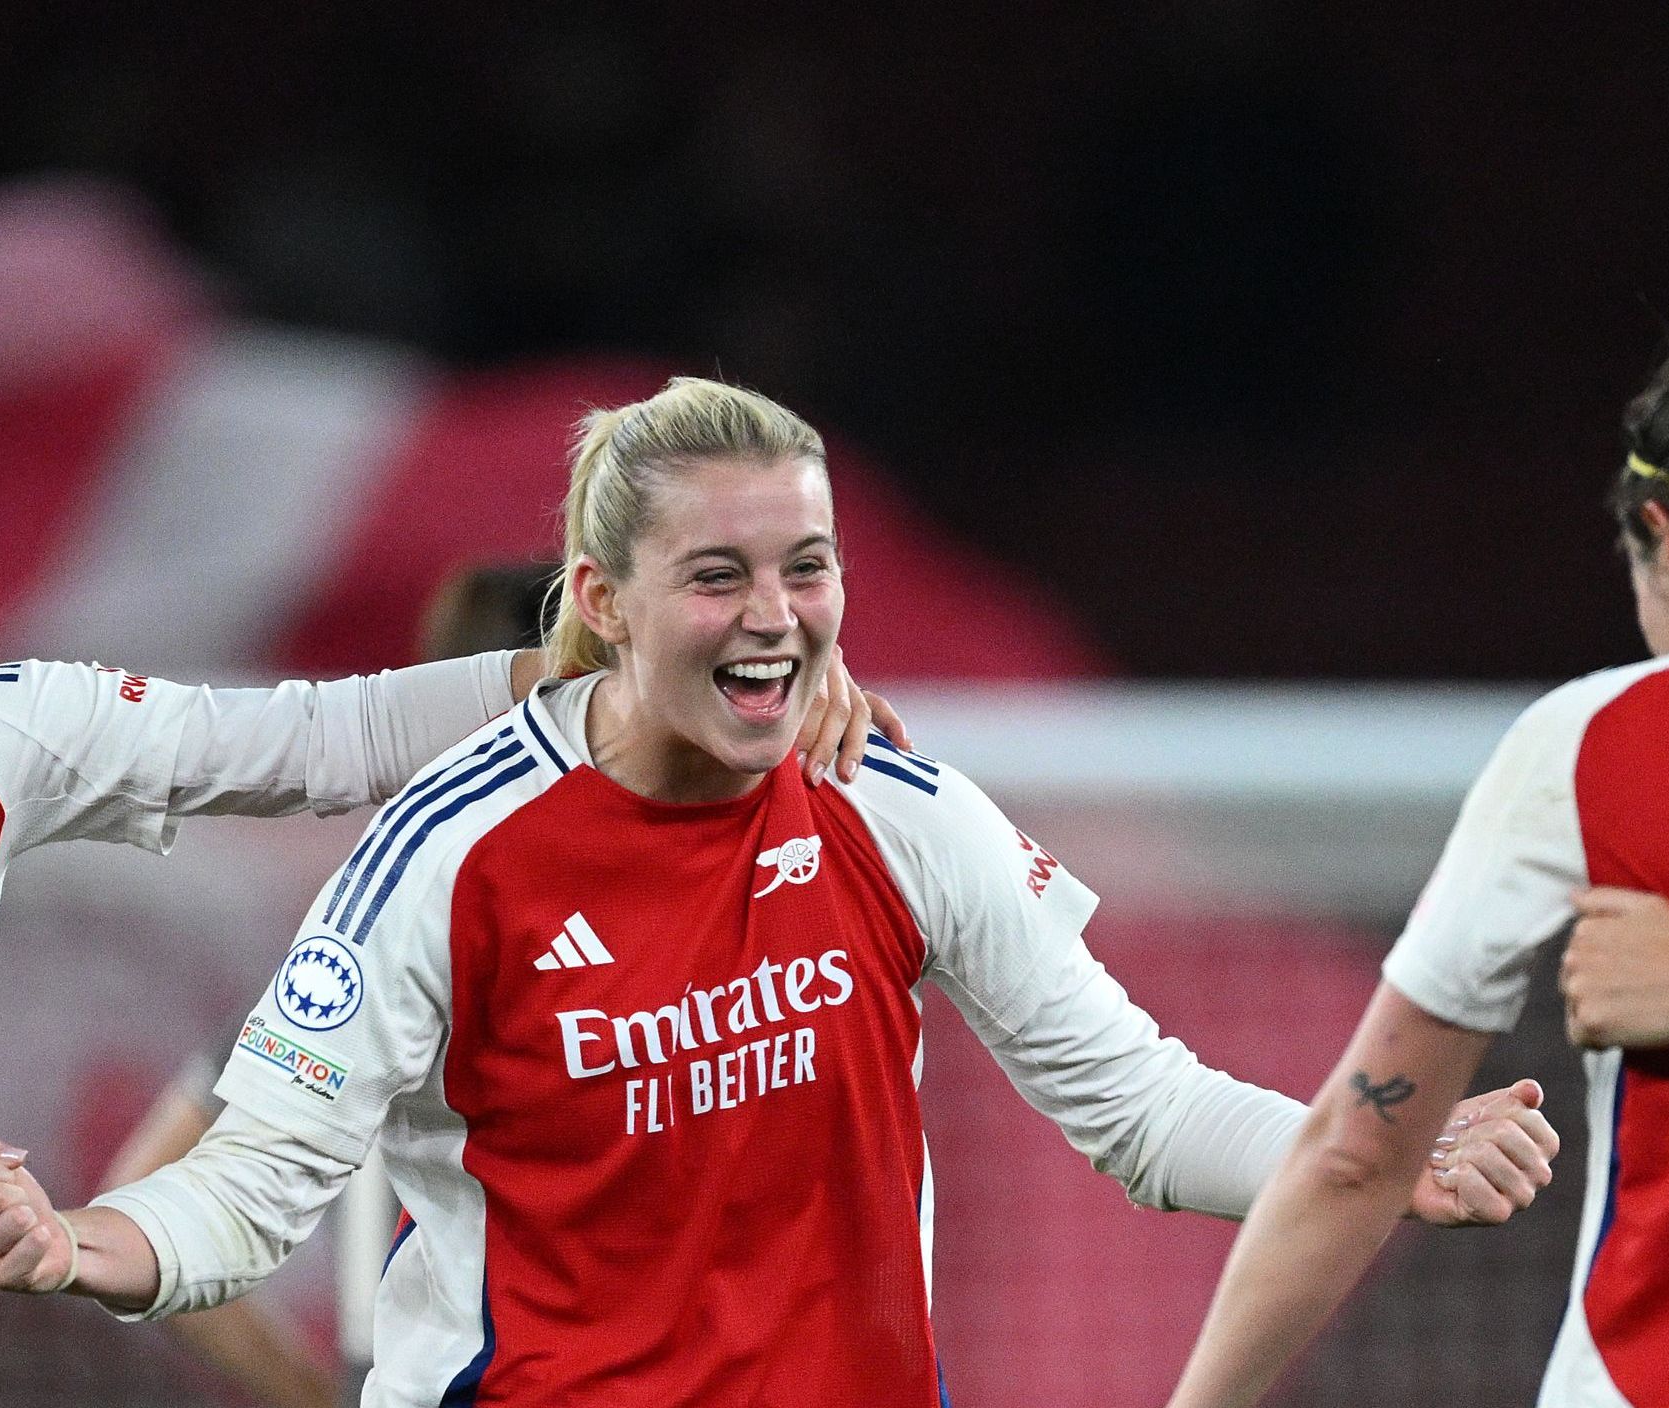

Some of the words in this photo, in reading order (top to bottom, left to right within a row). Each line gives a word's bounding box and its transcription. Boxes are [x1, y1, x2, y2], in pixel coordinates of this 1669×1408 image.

[240, 1026, 345, 1090] FOUNDATION
[555, 949, 853, 1079] Emirates
[626, 1069, 675, 1135] FL
[689, 1027, 816, 1115] BETTER
